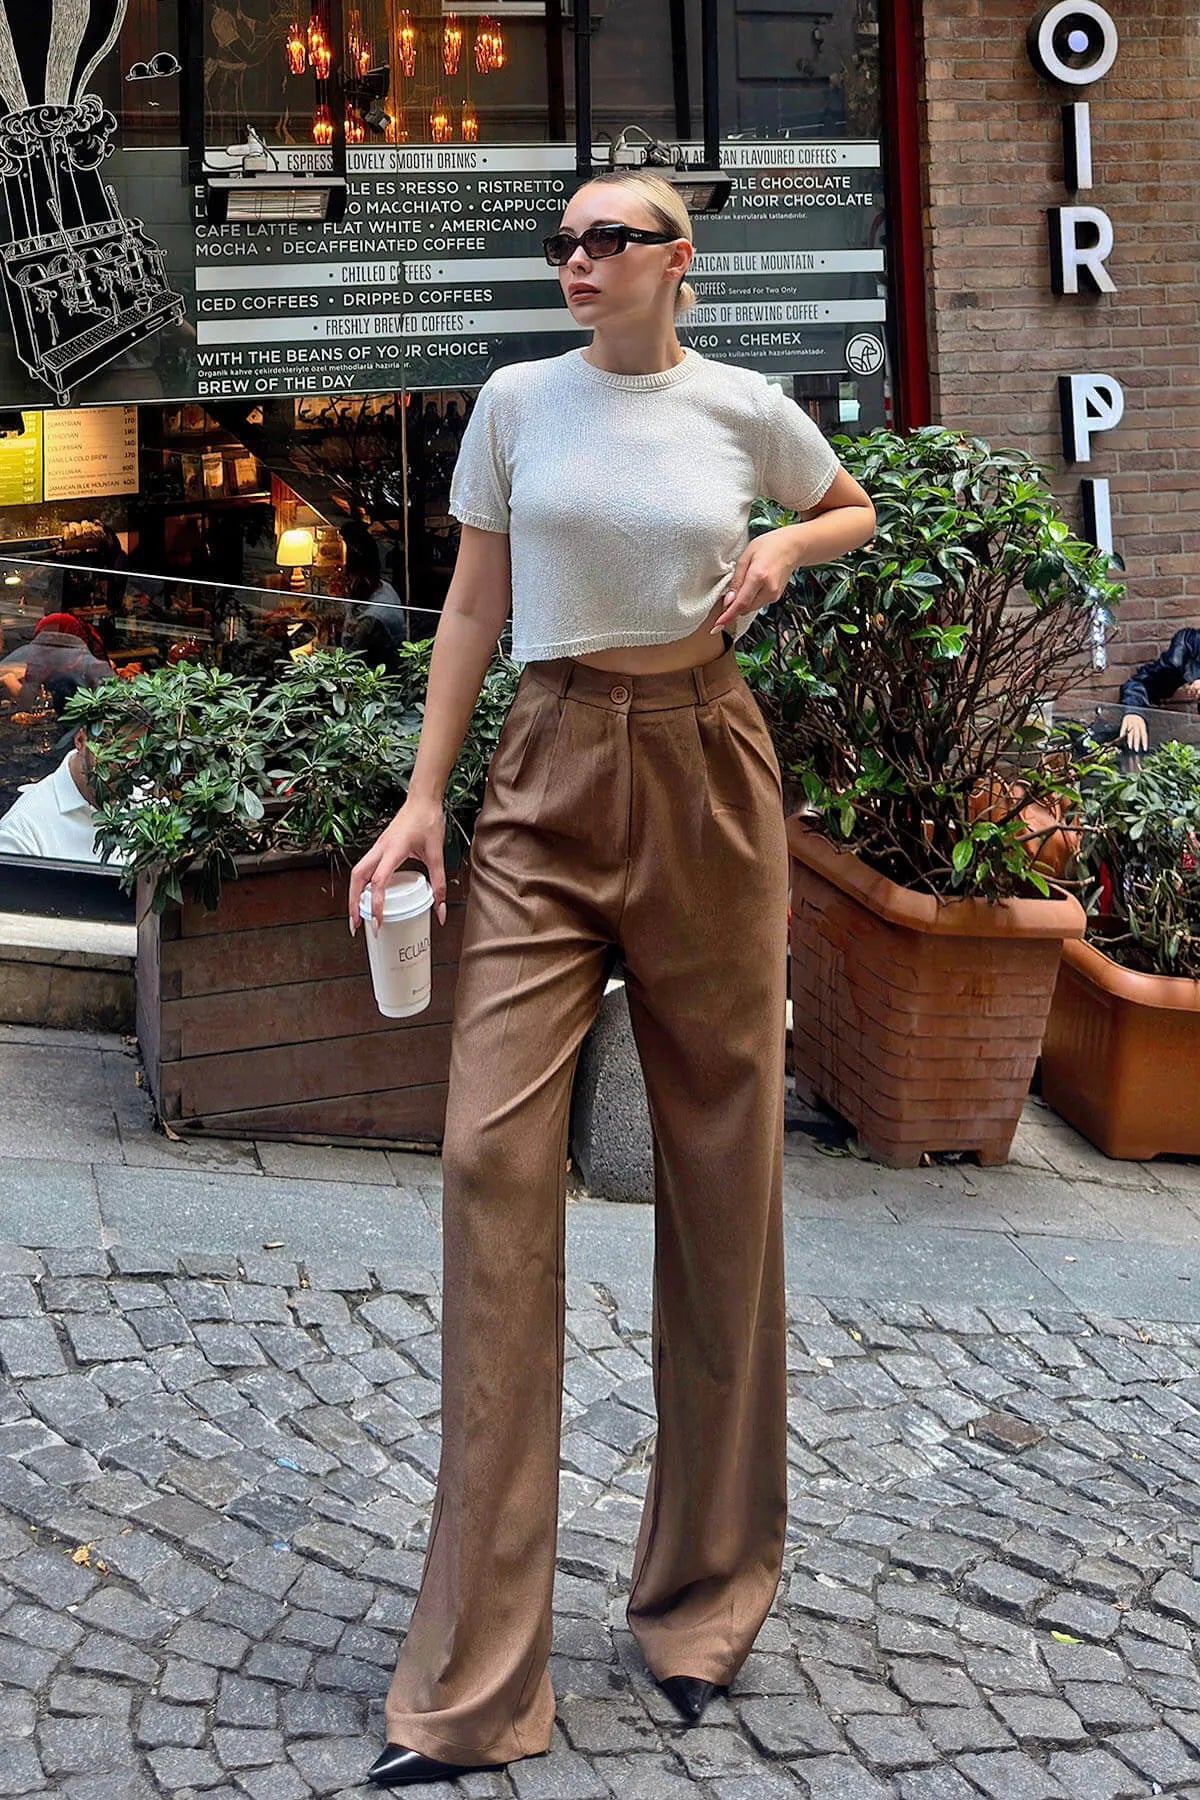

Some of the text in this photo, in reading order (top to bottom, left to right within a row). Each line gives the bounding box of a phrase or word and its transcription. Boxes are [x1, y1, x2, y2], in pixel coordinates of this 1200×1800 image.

[287, 151, 477, 171] ESPRESS LOVELY SMOOTH DRINKS
[741, 148, 795, 165] FLAVOURED
[798, 148, 837, 164] COFFEES
[477, 179, 565, 194] RISTRETTO
[760, 176, 851, 190] CHOCOLATE
[366, 200, 463, 215] MACCHIATO
[742, 194, 779, 207] NOIR
[783, 193, 873, 207] CHOCOLATE
[195, 218, 537, 238] CAFE LATTE FLAT WHITE AMERICANO
[195, 237, 486, 256] MOCHA DECAFFEINATED COFFEE
[733, 255, 757, 271] BLUE
[760, 254, 814, 270] MOUNTAIN
[341, 265, 386, 283] CHILLED
[694, 281, 798, 296] COFFEES Served For Two Only
[196, 289, 493, 312] ICED COFFEES DRIPPED COFFEES
[720, 307, 732, 322] OF
[735, 305, 783, 321] BREWING
[786, 304, 819, 320] COFFEE
[326, 315, 464, 335] FRESHLY BREWED COFFEES
[688, 332, 801, 348] V60 CHEMEX
[196, 351, 243, 367] WITH
[248, 350, 281, 364] THE
[286, 347, 343, 363] BEANS
[348, 346, 371, 360] OF
[426, 342, 489, 357] CHOICE
[197, 369, 229, 379] Organik
[230, 368, 253, 377] kahve
[310, 364, 328, 373] özel
[374, 361, 412, 370] hazırlaır.
[198, 374, 356, 395] BREW OF THE DAY
